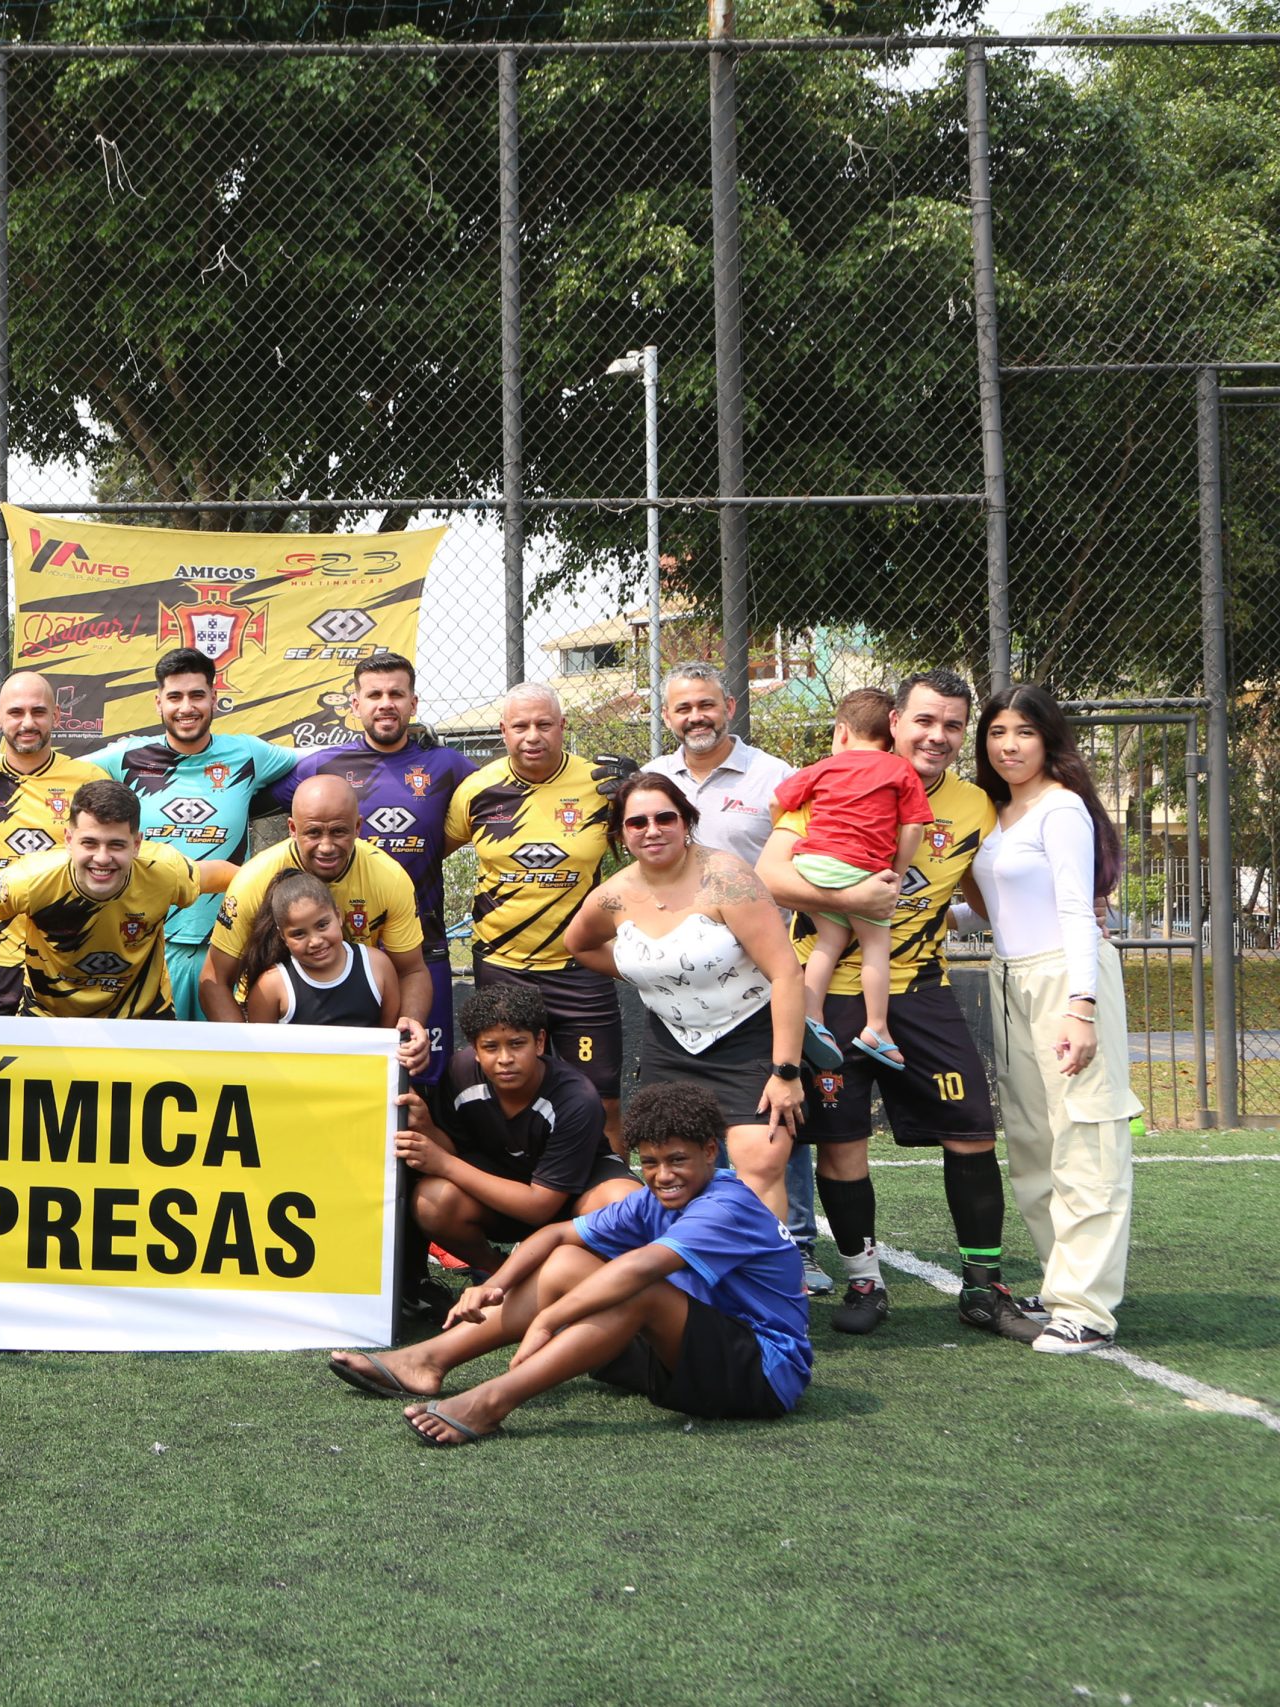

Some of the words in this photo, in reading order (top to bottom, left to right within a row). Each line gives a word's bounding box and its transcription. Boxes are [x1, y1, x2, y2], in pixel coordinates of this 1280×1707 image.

[72, 560, 130, 578] WFG
[174, 565, 257, 580] AMIGOS
[145, 825, 183, 838] SE7E
[184, 825, 227, 839] TR3S
[389, 836, 426, 848] TR3S
[500, 870, 536, 883] SE7E
[537, 870, 580, 883] TR3S
[579, 1036, 592, 1062] 8
[932, 1072, 965, 1101] 10
